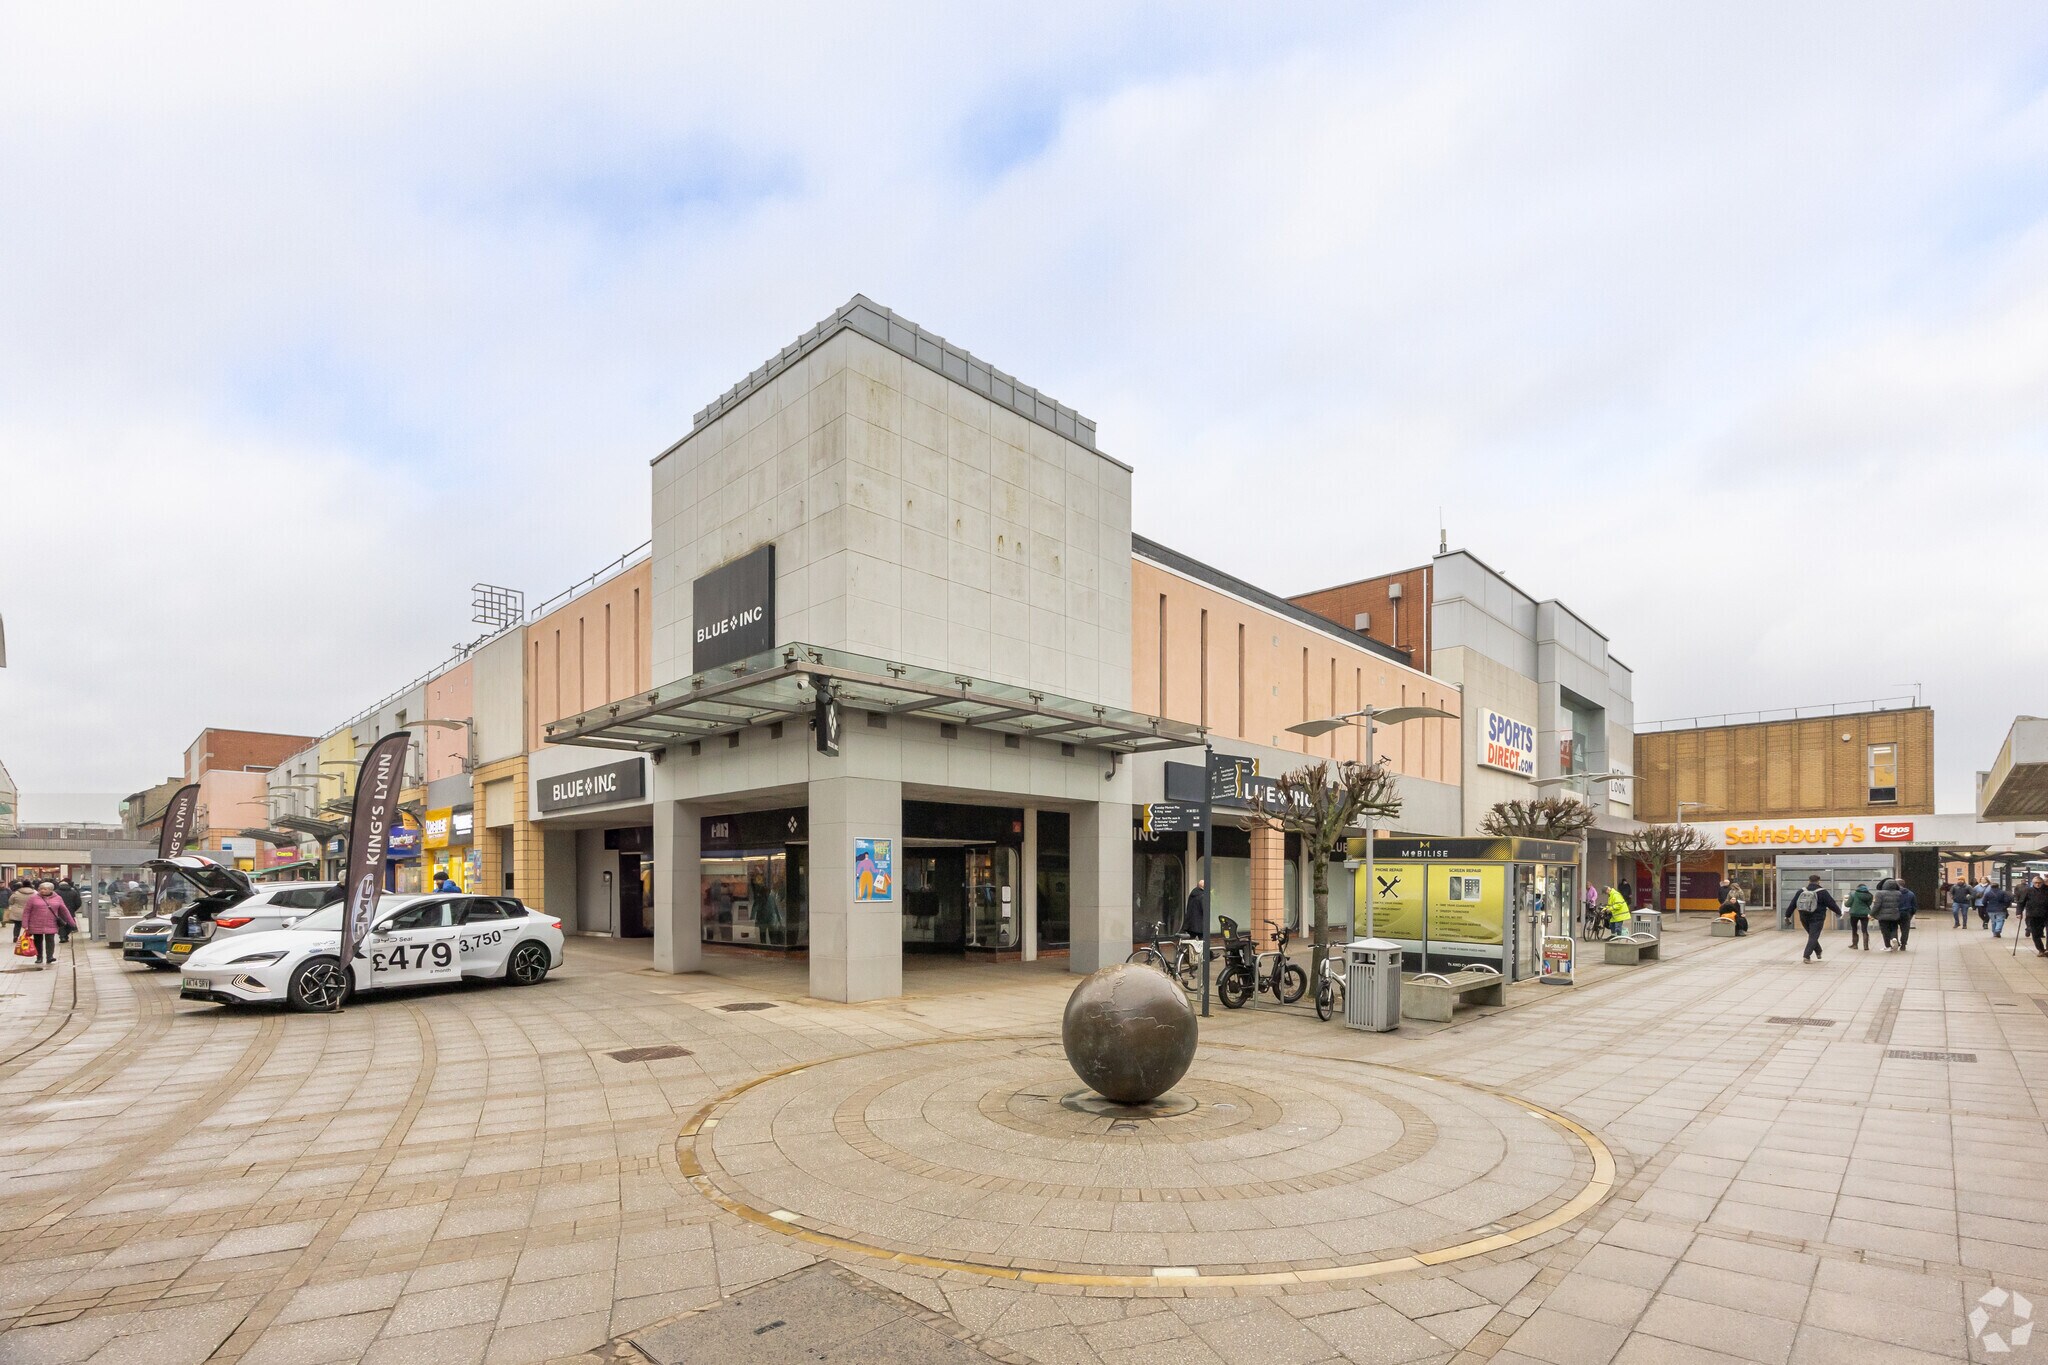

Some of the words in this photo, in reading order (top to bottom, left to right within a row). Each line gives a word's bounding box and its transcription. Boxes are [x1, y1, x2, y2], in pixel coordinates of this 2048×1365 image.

[697, 618, 729, 643] BLUE
[739, 606, 763, 627] INC
[1488, 712, 1533, 753] SPORTS
[1487, 742, 1533, 774] DIRECT.COM
[374, 753, 392, 800] LYNN
[553, 779, 584, 801] BLUE
[594, 772, 616, 794] INC
[1610, 782, 1626, 795] LOOK
[1237, 782, 1276, 803] LUE
[169, 831, 182, 859] NG'S
[176, 798, 188, 828] LYNN
[366, 805, 384, 865] KING'S
[1724, 822, 1865, 846] Sainsbury's
[1878, 825, 1910, 835] Argos
[1331, 839, 1348, 853] LUE
[1401, 850, 1449, 858] MOBILISE
[459, 930, 501, 954] 3,750
[372, 942, 452, 972] £479
